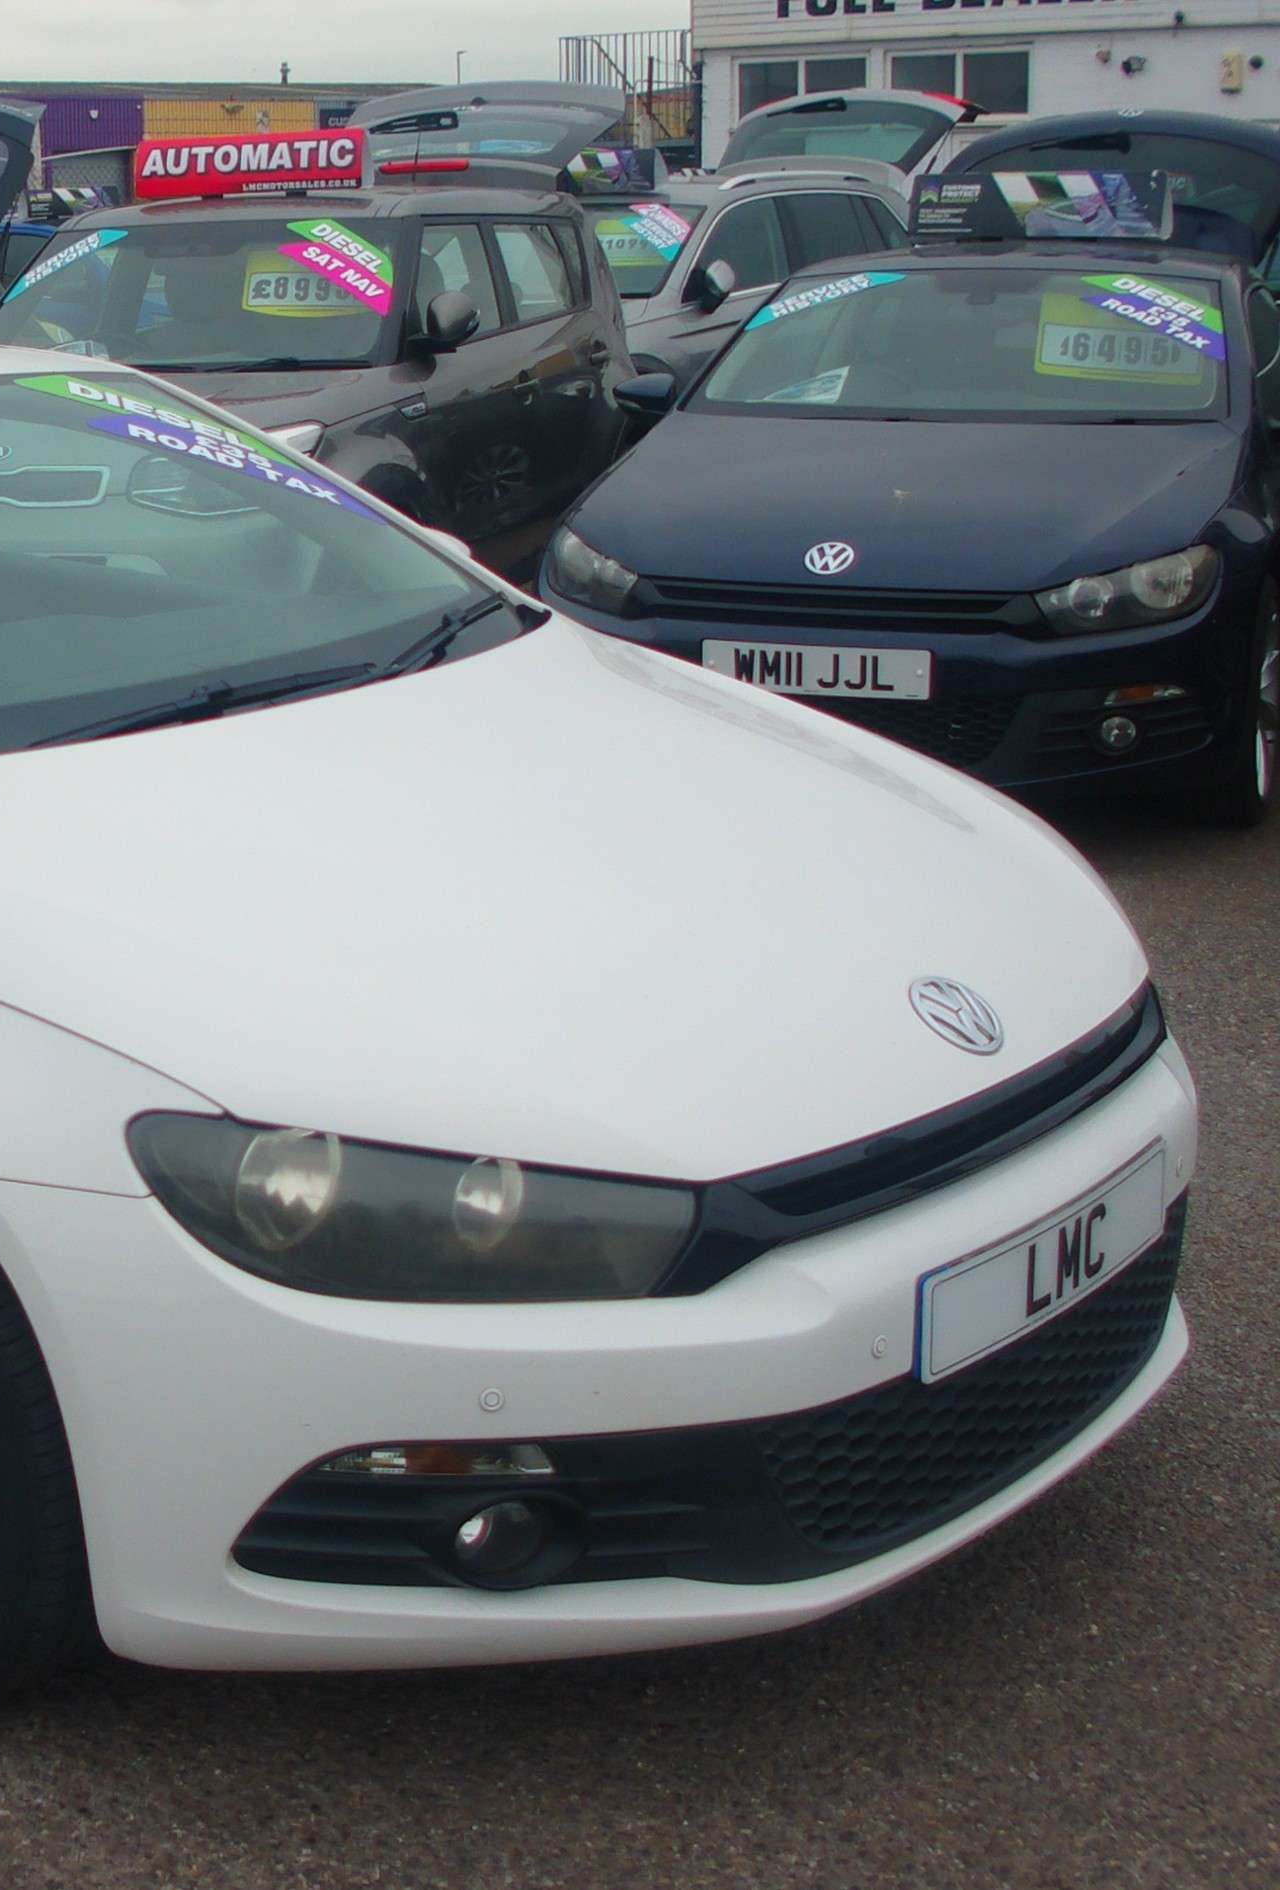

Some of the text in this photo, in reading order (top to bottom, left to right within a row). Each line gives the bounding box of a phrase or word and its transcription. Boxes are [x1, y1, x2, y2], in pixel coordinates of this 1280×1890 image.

[141, 138, 355, 177] AUTOMATIC
[242, 179, 357, 191] LMCMOTORSALES.CO.UK
[310, 222, 383, 274] DIESEL
[302, 246, 385, 298] SAT NAV
[1100, 298, 1212, 349] ROAD TAX
[1112, 278, 1205, 322] DIESEL
[1147, 305, 1191, 327] £35
[67, 380, 259, 452] DIESEL
[126, 423, 342, 505] ROAD TAX
[195, 433, 273, 469] £35
[733, 647, 894, 691] WM11 JJL
[1026, 1202, 1106, 1318] LMC
